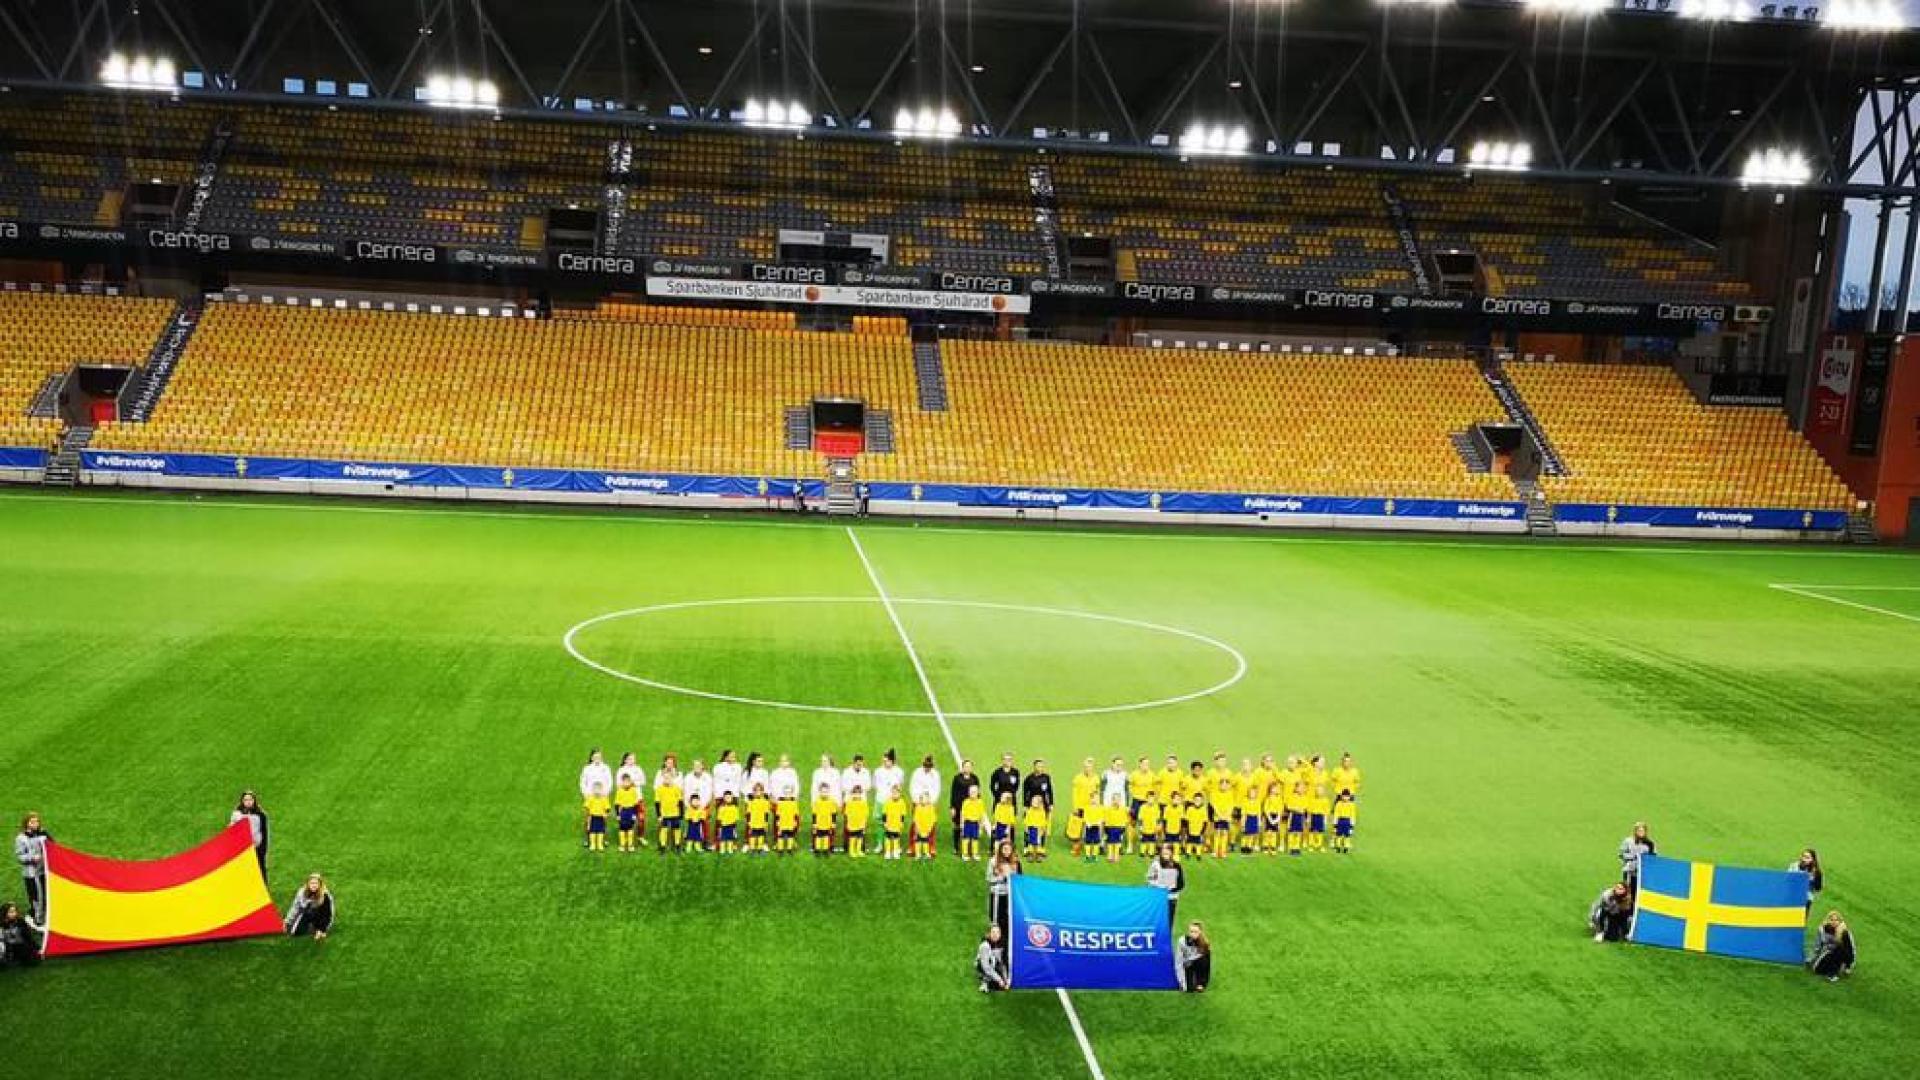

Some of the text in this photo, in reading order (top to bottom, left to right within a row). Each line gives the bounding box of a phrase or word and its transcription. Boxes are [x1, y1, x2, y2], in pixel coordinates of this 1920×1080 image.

[666, 281, 802, 299] Sparbanken Sjuhärad
[856, 290, 990, 310] Sparbanken Sjuhärad
[1058, 930, 1157, 950] RESPECT
